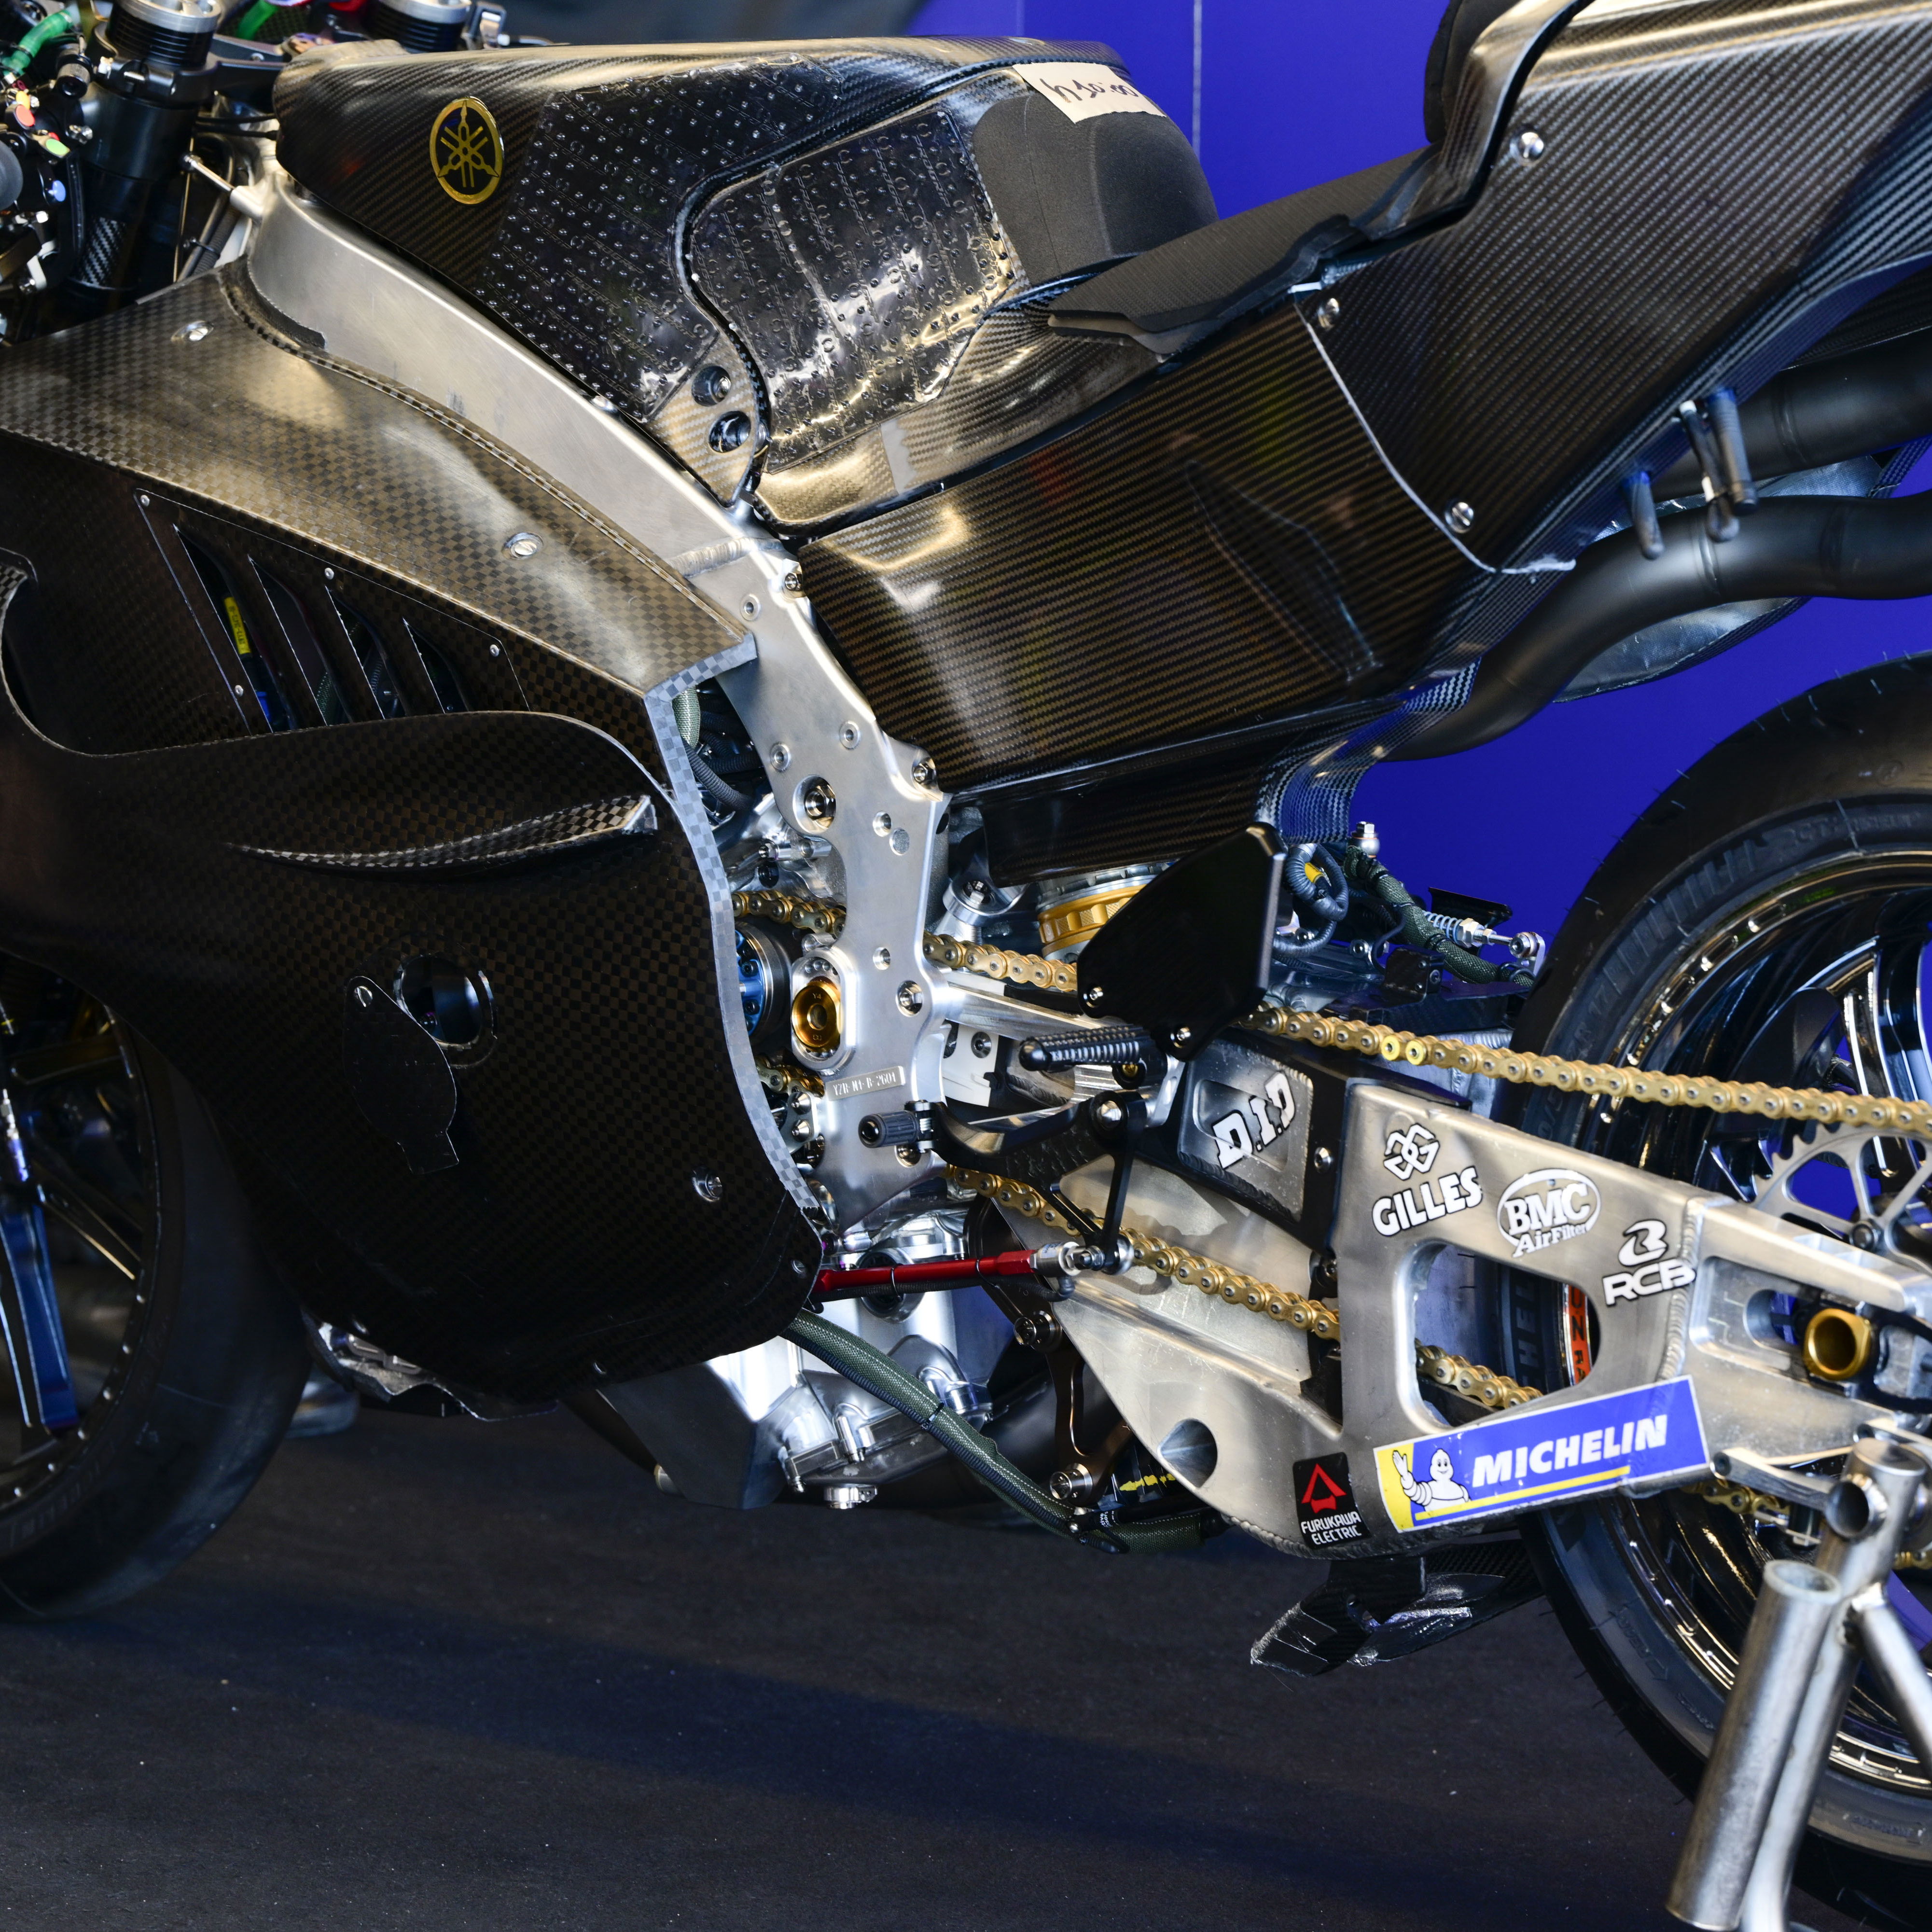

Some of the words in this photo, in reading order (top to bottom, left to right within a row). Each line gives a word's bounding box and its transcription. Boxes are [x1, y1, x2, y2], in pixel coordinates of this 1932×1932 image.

[1372, 1166, 1484, 1236] GILLES
[1503, 1182, 1591, 1236] BMC
[1602, 1258, 1696, 1307] RCB
[1472, 1414, 1669, 1487] MICHELIN
[1300, 1511, 1362, 1535] FURUKAWA
[1312, 1525, 1362, 1546] ELECTRIC
